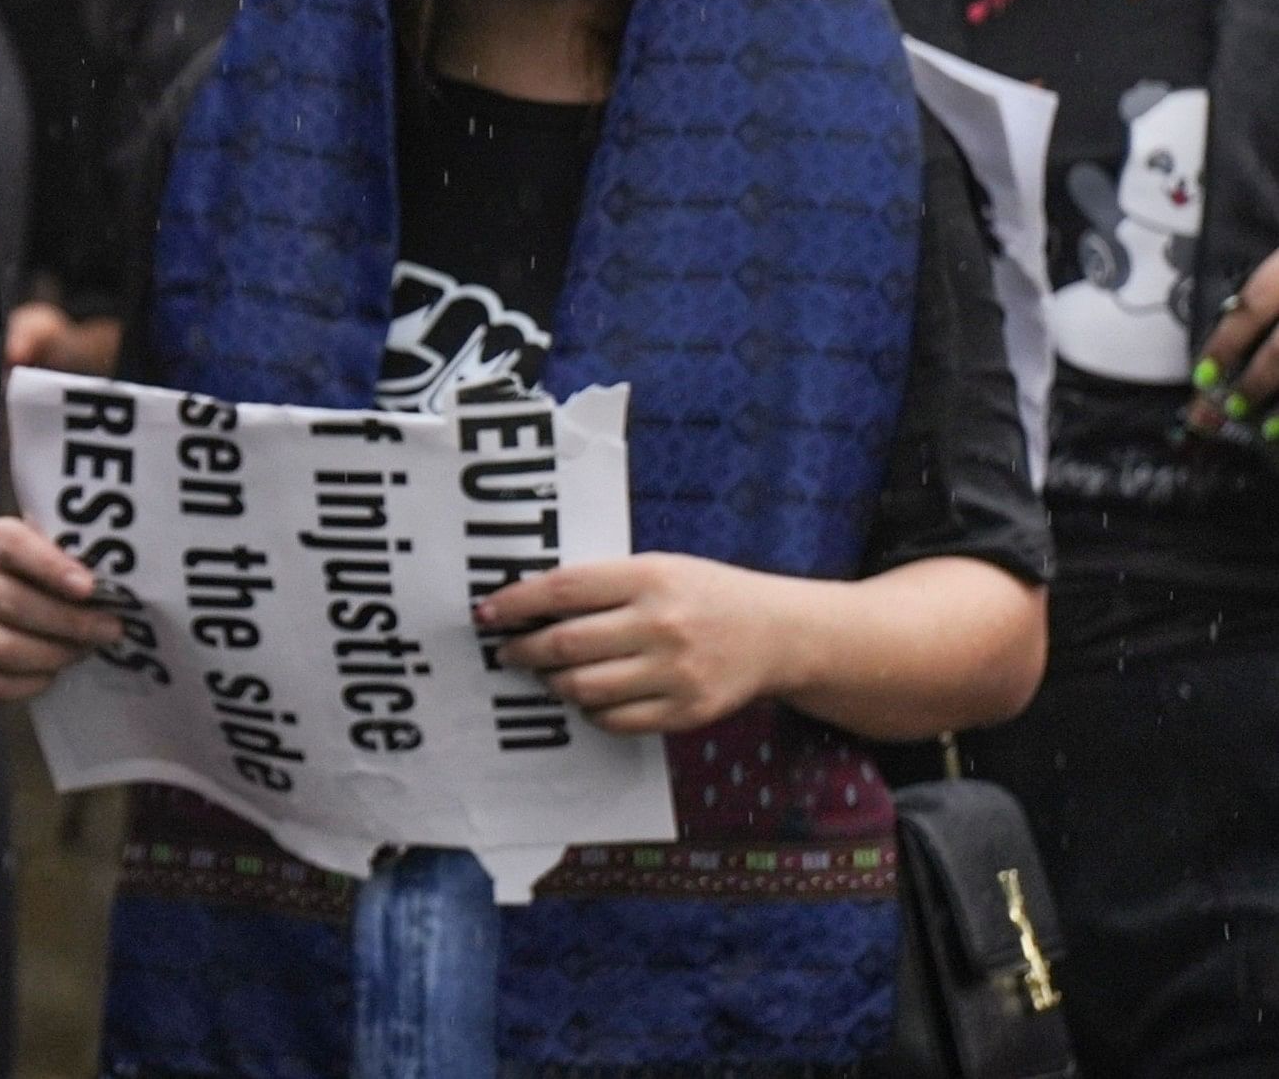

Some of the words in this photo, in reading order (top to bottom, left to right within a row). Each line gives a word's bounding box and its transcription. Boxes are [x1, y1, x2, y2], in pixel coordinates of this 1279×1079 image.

[183, 544, 277, 651] the
[298, 469, 431, 755] injustice
[204, 669, 308, 795] side
